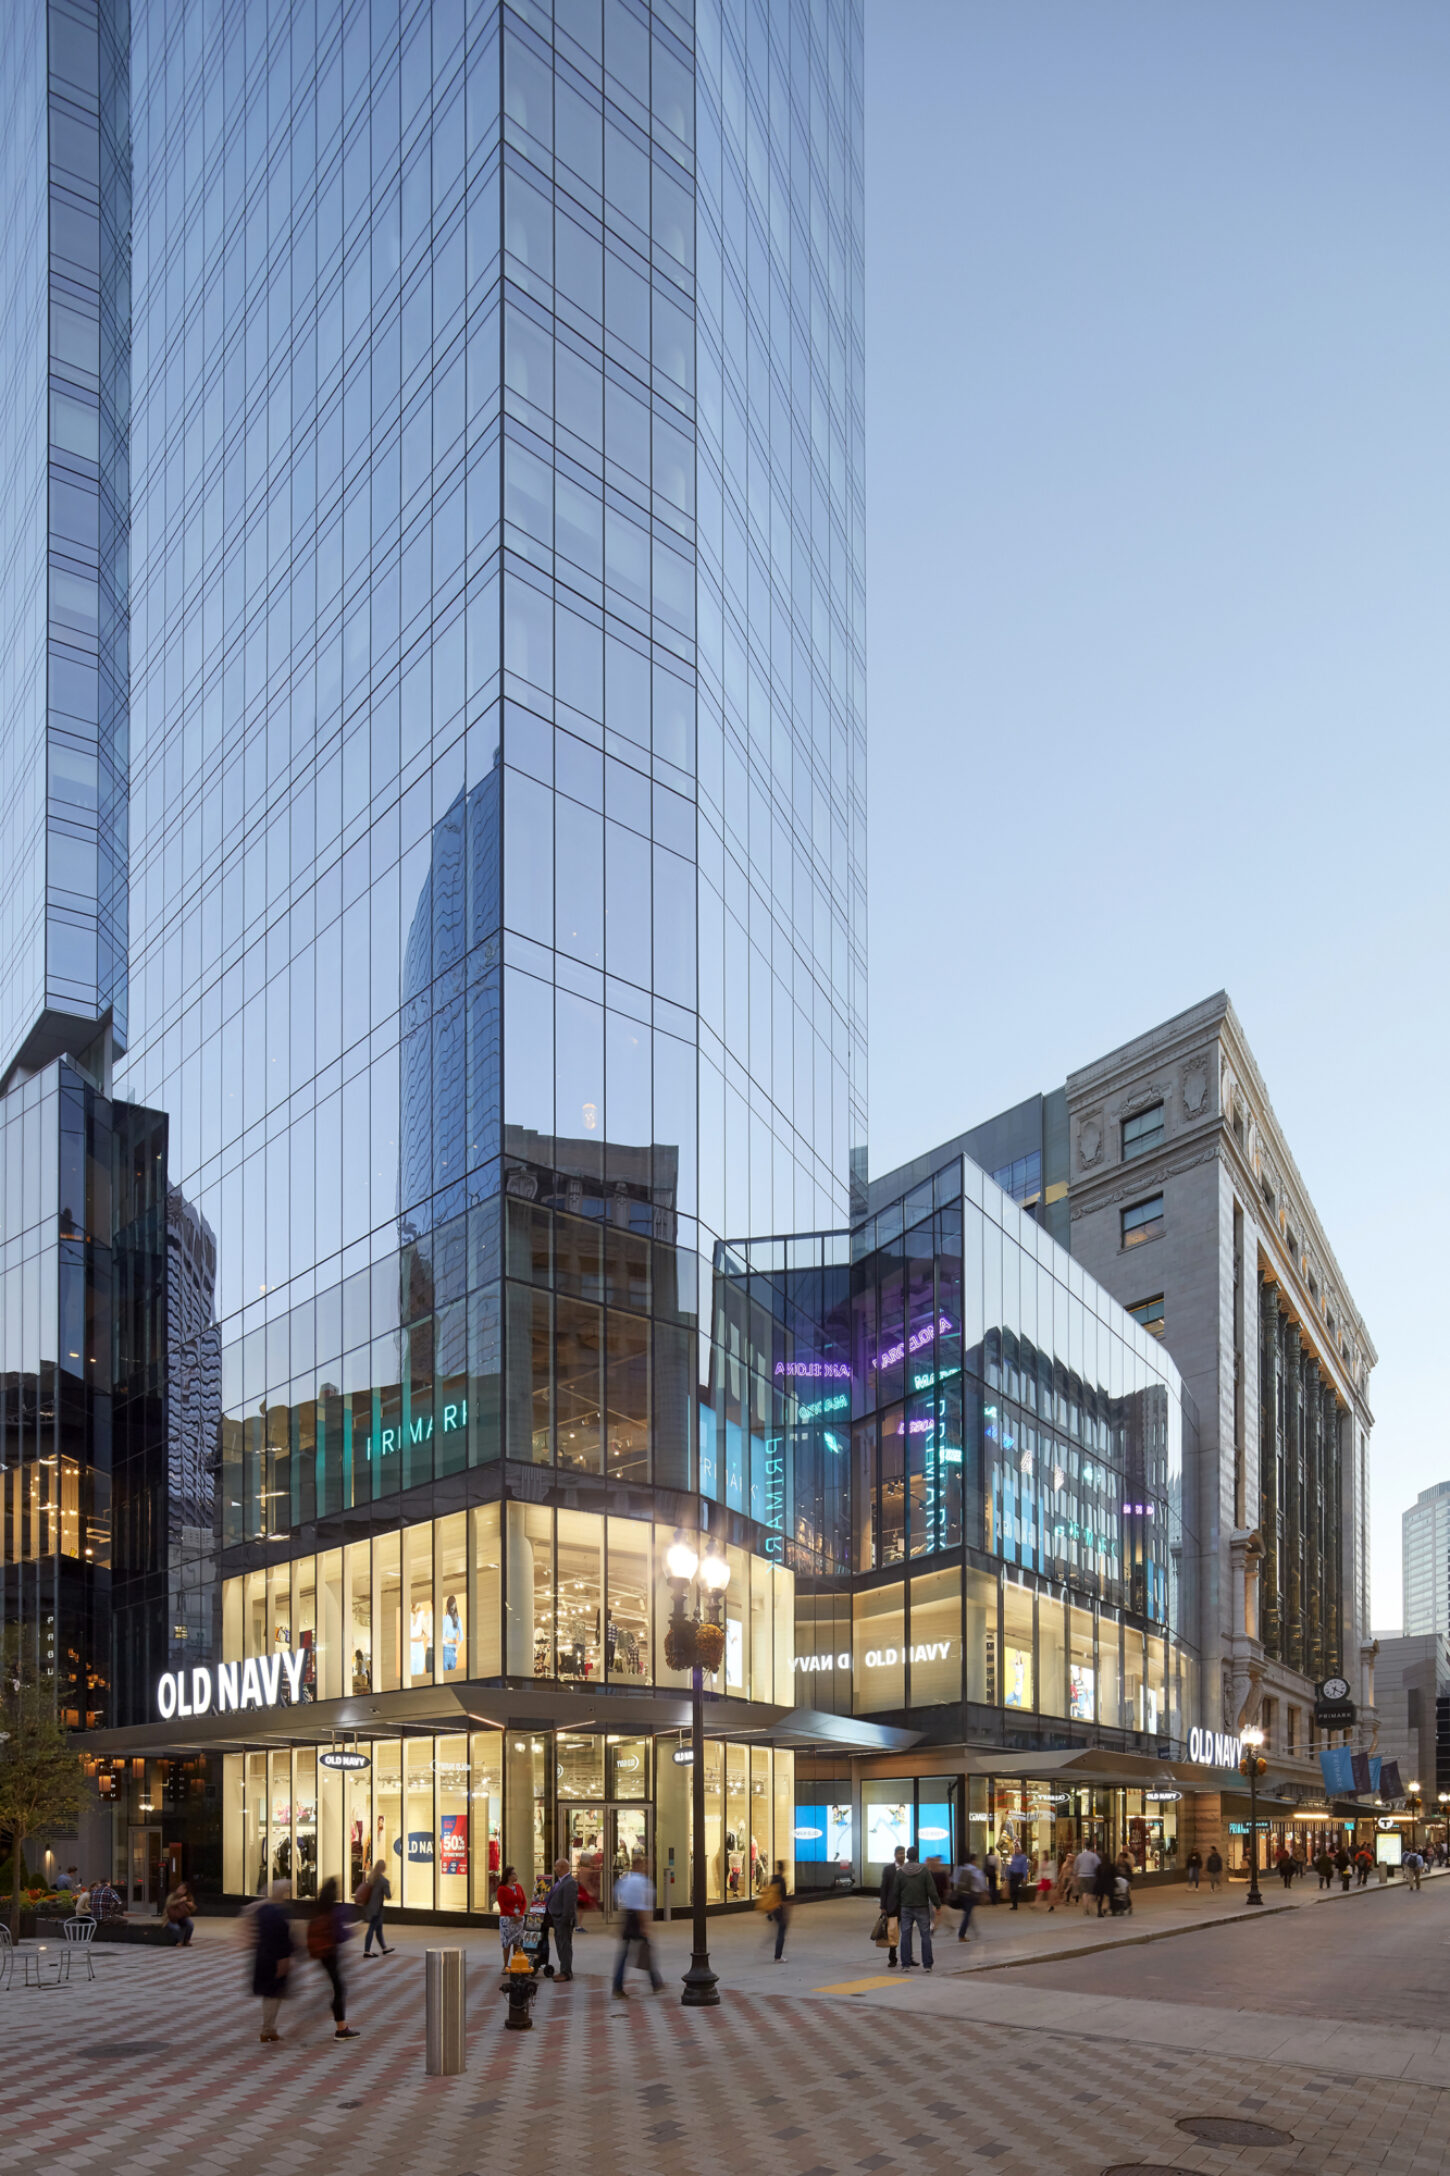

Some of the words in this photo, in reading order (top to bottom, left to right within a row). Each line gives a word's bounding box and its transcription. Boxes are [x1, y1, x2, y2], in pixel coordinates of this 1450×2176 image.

[865, 1649, 898, 1668] OLD
[158, 1668, 212, 1719] OLD
[218, 1648, 305, 1711] NAVY
[1318, 1711, 1351, 1719] PRIMARK
[1190, 1726, 1213, 1764] OLD
[1215, 1732, 1242, 1769] NAVY
[325, 1756, 341, 1765] OLD
[343, 1756, 365, 1766] NAVY
